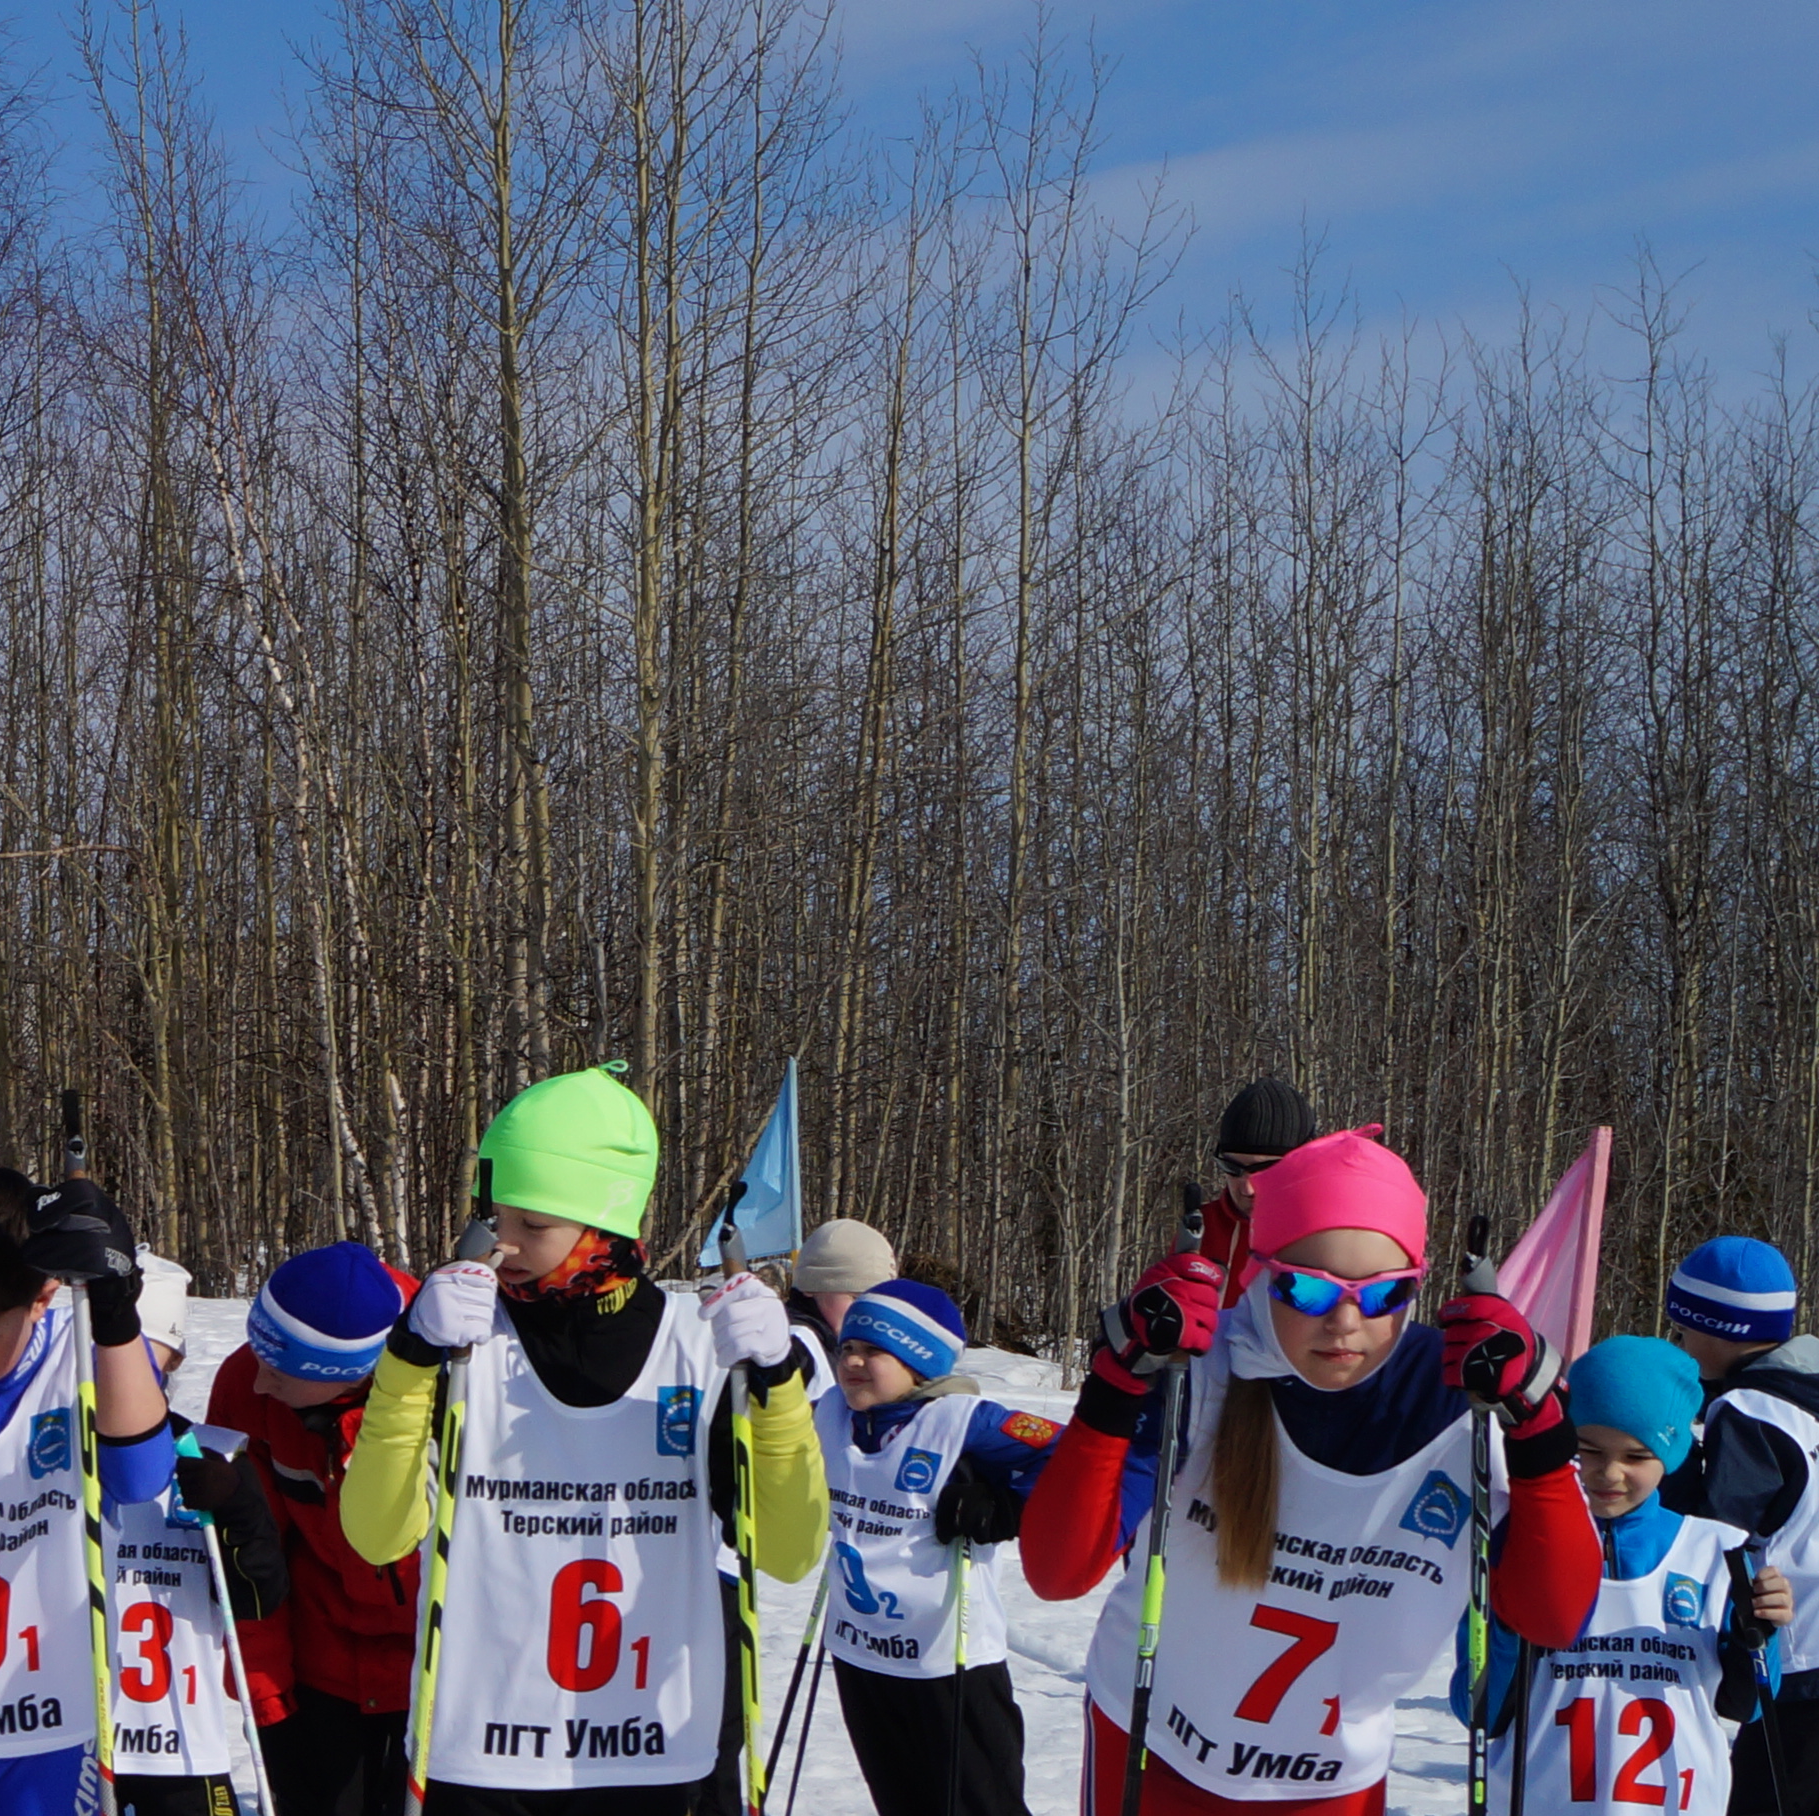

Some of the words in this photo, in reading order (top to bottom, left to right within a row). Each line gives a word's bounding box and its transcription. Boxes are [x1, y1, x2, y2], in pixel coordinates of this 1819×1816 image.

[846, 1313, 934, 1361] РОССИИ
[1670, 1301, 1752, 1335] РОССИИ
[465, 1475, 617, 1502] Мурманская
[501, 1510, 603, 1538] Терский
[610, 1511, 678, 1539] район
[856, 1518, 903, 1537] район
[869, 1499, 931, 1520] область
[0, 1517, 49, 1554] район
[143, 1542, 208, 1566] область
[1186, 1499, 1347, 1564] Мунская
[1349, 1545, 1445, 1586] область
[132, 1567, 182, 1588] район
[835, 1541, 879, 1615] 9
[878, 1591, 905, 1620] 2
[546, 1558, 624, 1693] 6
[630, 1636, 651, 1690] 1
[18, 1625, 41, 1672] 1
[181, 1665, 197, 1706] 1
[1233, 1603, 1339, 1724] 7
[1319, 1694, 1341, 1737] 1
[1630, 1661, 1681, 1684] район
[483, 1722, 552, 1758] пгт
[564, 1716, 665, 1758] Умба
[1165, 1704, 1218, 1764] пгт
[1226, 1742, 1343, 1782] Умба
[1555, 1697, 1676, 1806] 12
[1678, 1768, 1695, 1811] 1
